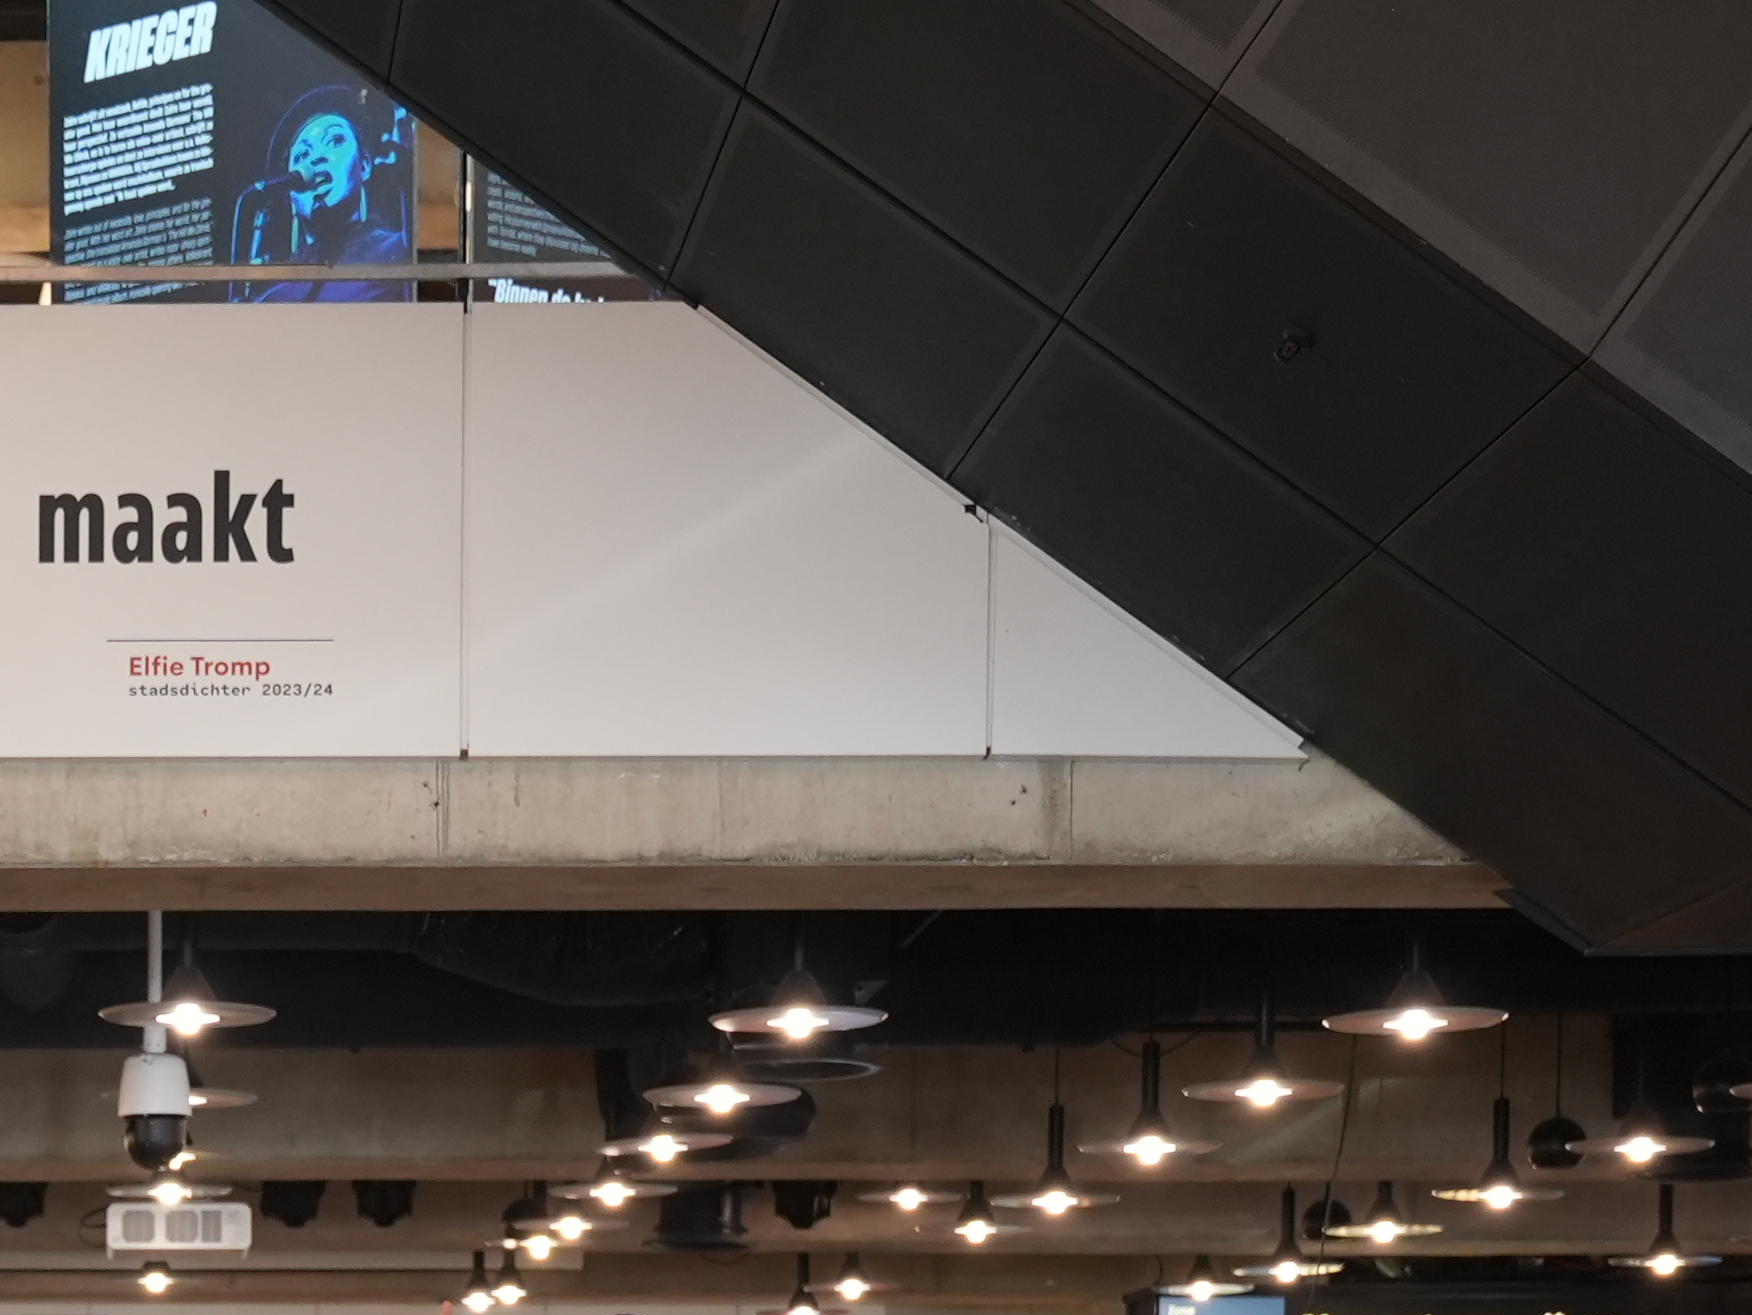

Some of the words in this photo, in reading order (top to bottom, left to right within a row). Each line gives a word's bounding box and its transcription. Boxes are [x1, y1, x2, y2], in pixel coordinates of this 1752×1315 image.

[84, 1, 218, 83] KRIEGER
[39, 470, 294, 564] maakt
[129, 656, 184, 676] Elfie
[191, 656, 271, 681] Tromp
[129, 683, 251, 697] stadsdichter
[262, 683, 334, 698] 2023/24
